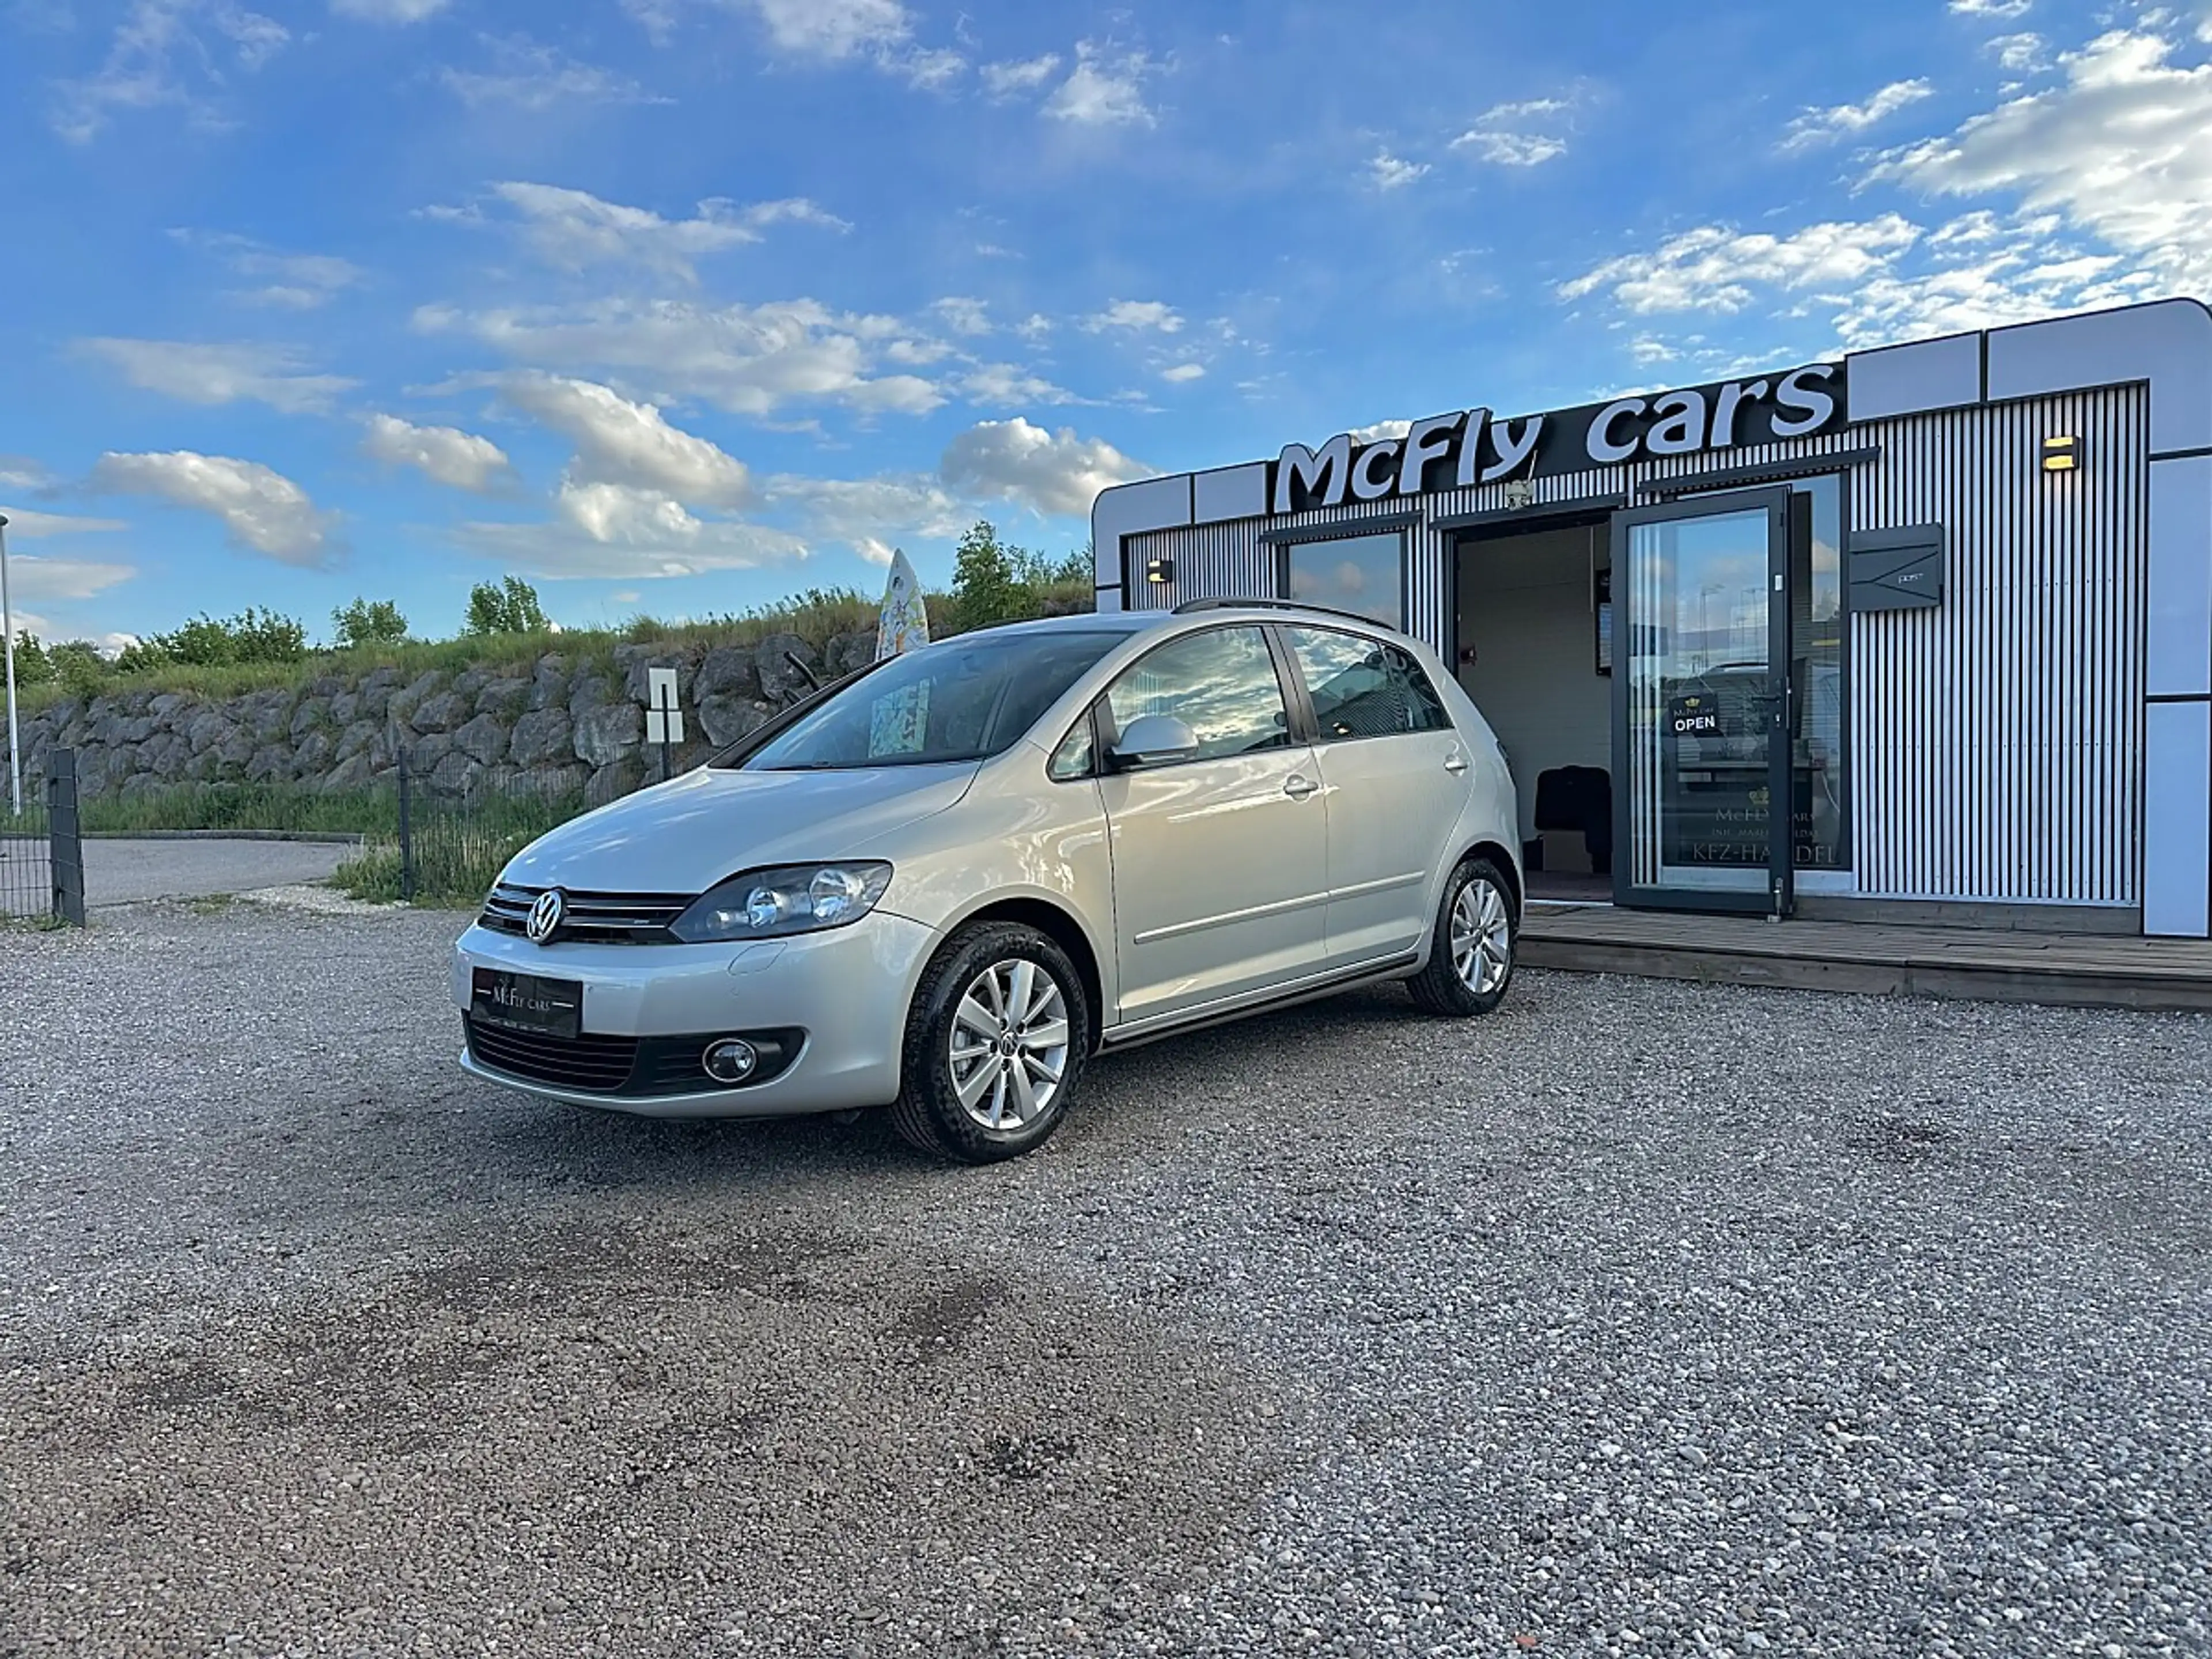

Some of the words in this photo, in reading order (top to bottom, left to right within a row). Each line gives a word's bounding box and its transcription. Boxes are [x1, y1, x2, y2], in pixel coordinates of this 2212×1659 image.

[1274, 407, 1547, 514] McFly
[1586, 363, 1835, 463] cars
[1675, 715, 1715, 732] OPEN
[1693, 842, 1838, 863] KFZ-HADEL
